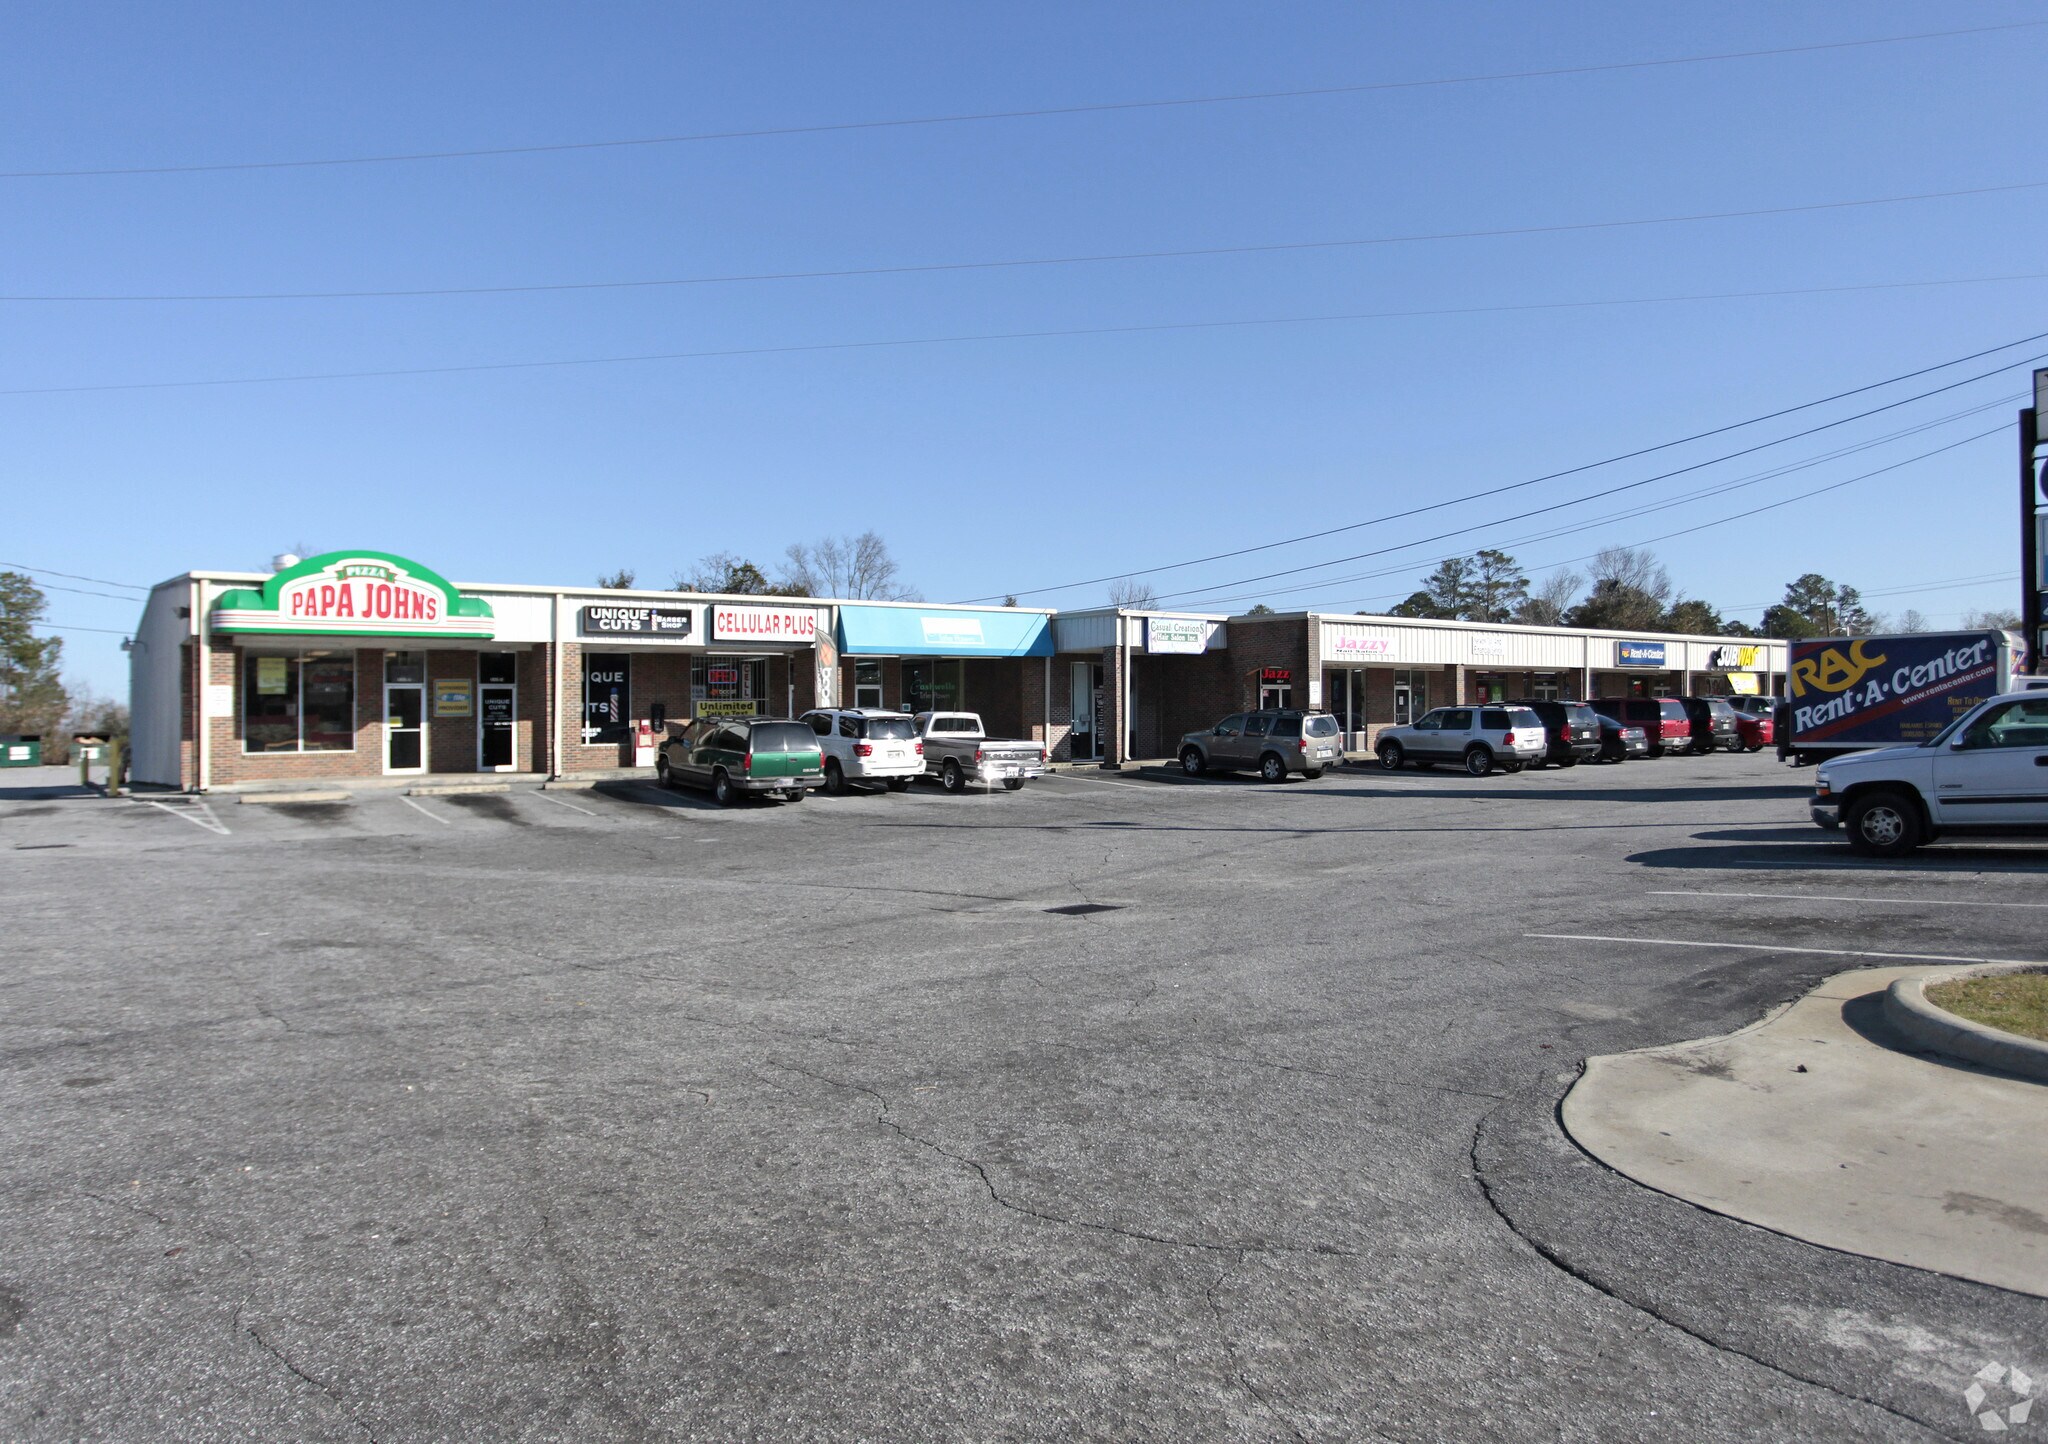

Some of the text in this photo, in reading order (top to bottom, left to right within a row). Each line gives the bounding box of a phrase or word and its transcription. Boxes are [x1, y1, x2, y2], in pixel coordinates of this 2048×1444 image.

[346, 566, 387, 578] PIZZA
[292, 583, 354, 617] PAPA
[590, 608, 650, 620] UNIQUE
[599, 619, 642, 631] CUTS
[717, 612, 814, 635] CELLULAR PLUS
[1151, 621, 1171, 632] Casual
[1171, 633, 1186, 641] Salon
[1335, 637, 1389, 653] Jazzy
[1717, 645, 1761, 667] SUBWAY
[1262, 668, 1290, 679] Jazz
[1791, 640, 1888, 698] RAC
[1901, 664, 1994, 705] www.rentacenter.com
[700, 702, 753, 711] Unlimited
